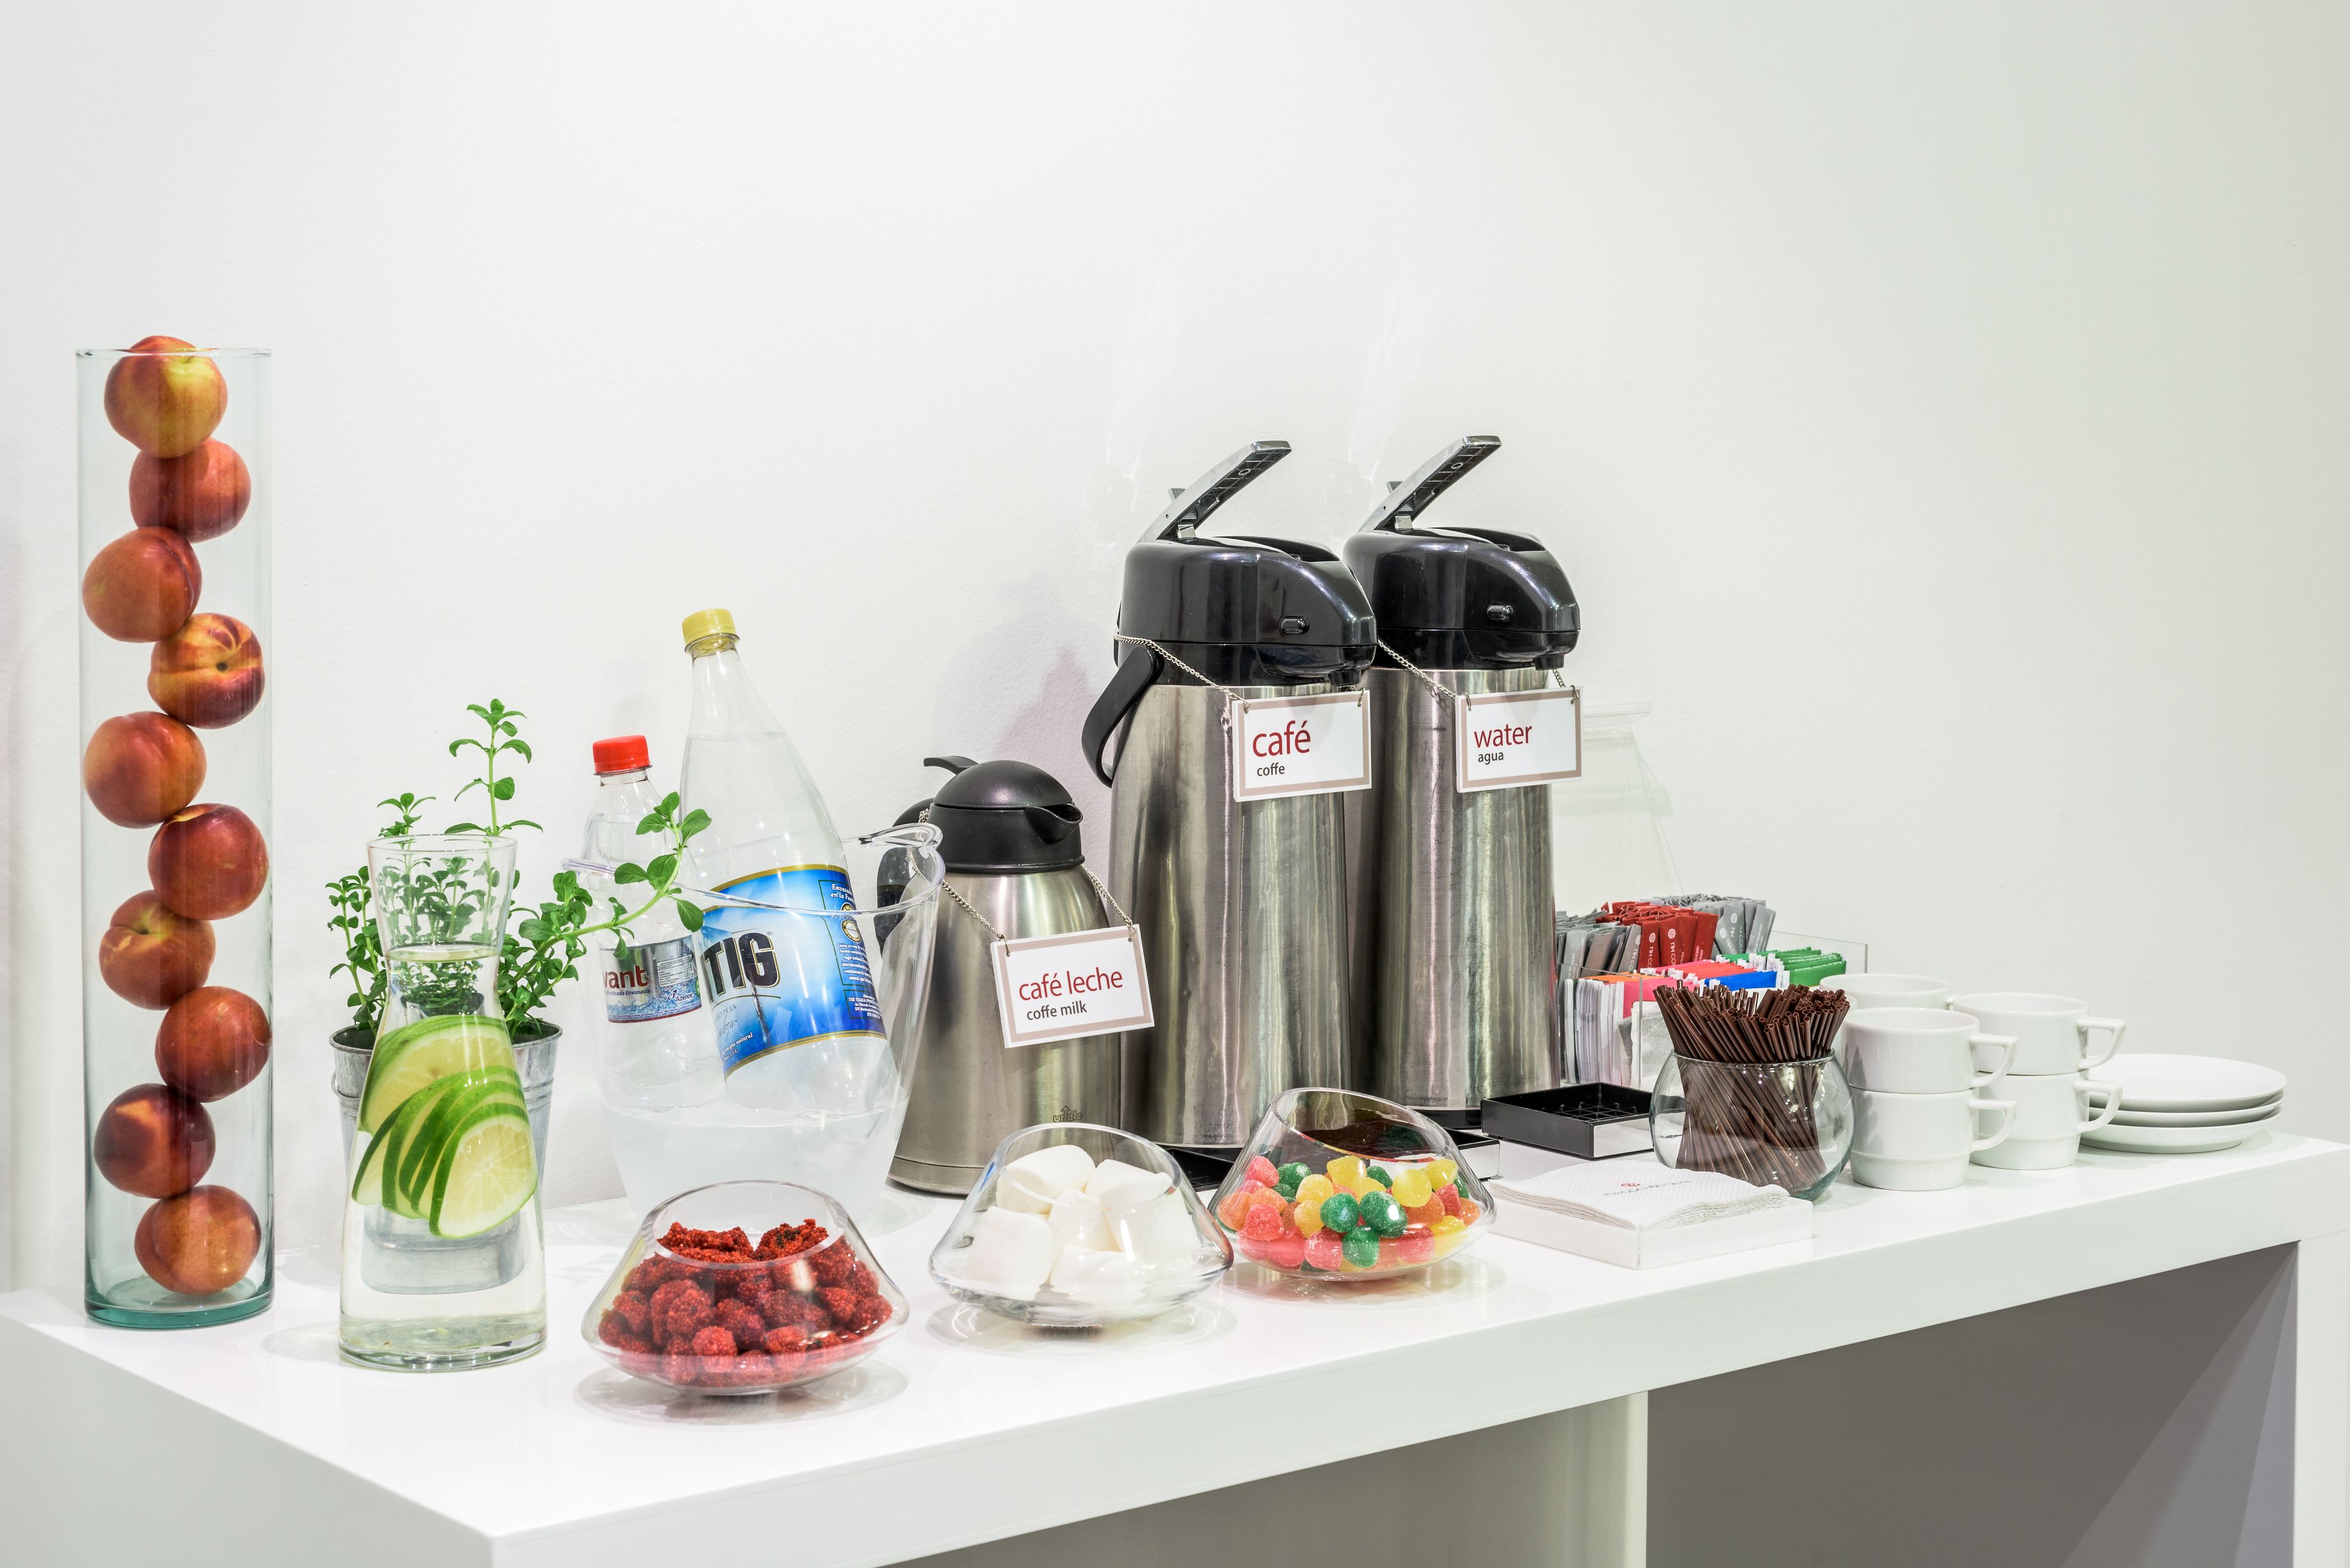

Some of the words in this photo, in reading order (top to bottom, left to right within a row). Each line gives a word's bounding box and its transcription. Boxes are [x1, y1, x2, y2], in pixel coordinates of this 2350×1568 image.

[1252, 720, 1310, 758] café
[1473, 725, 1532, 748] water
[1478, 751, 1504, 765] agua
[1257, 762, 1285, 776] coffe
[700, 932, 780, 1004] TIG
[1019, 972, 1062, 1001] café
[1066, 967, 1122, 995] leche
[1026, 1004, 1058, 1020] coffe
[1060, 1000, 1088, 1016] milk
[736, 1032, 754, 1045] natural
